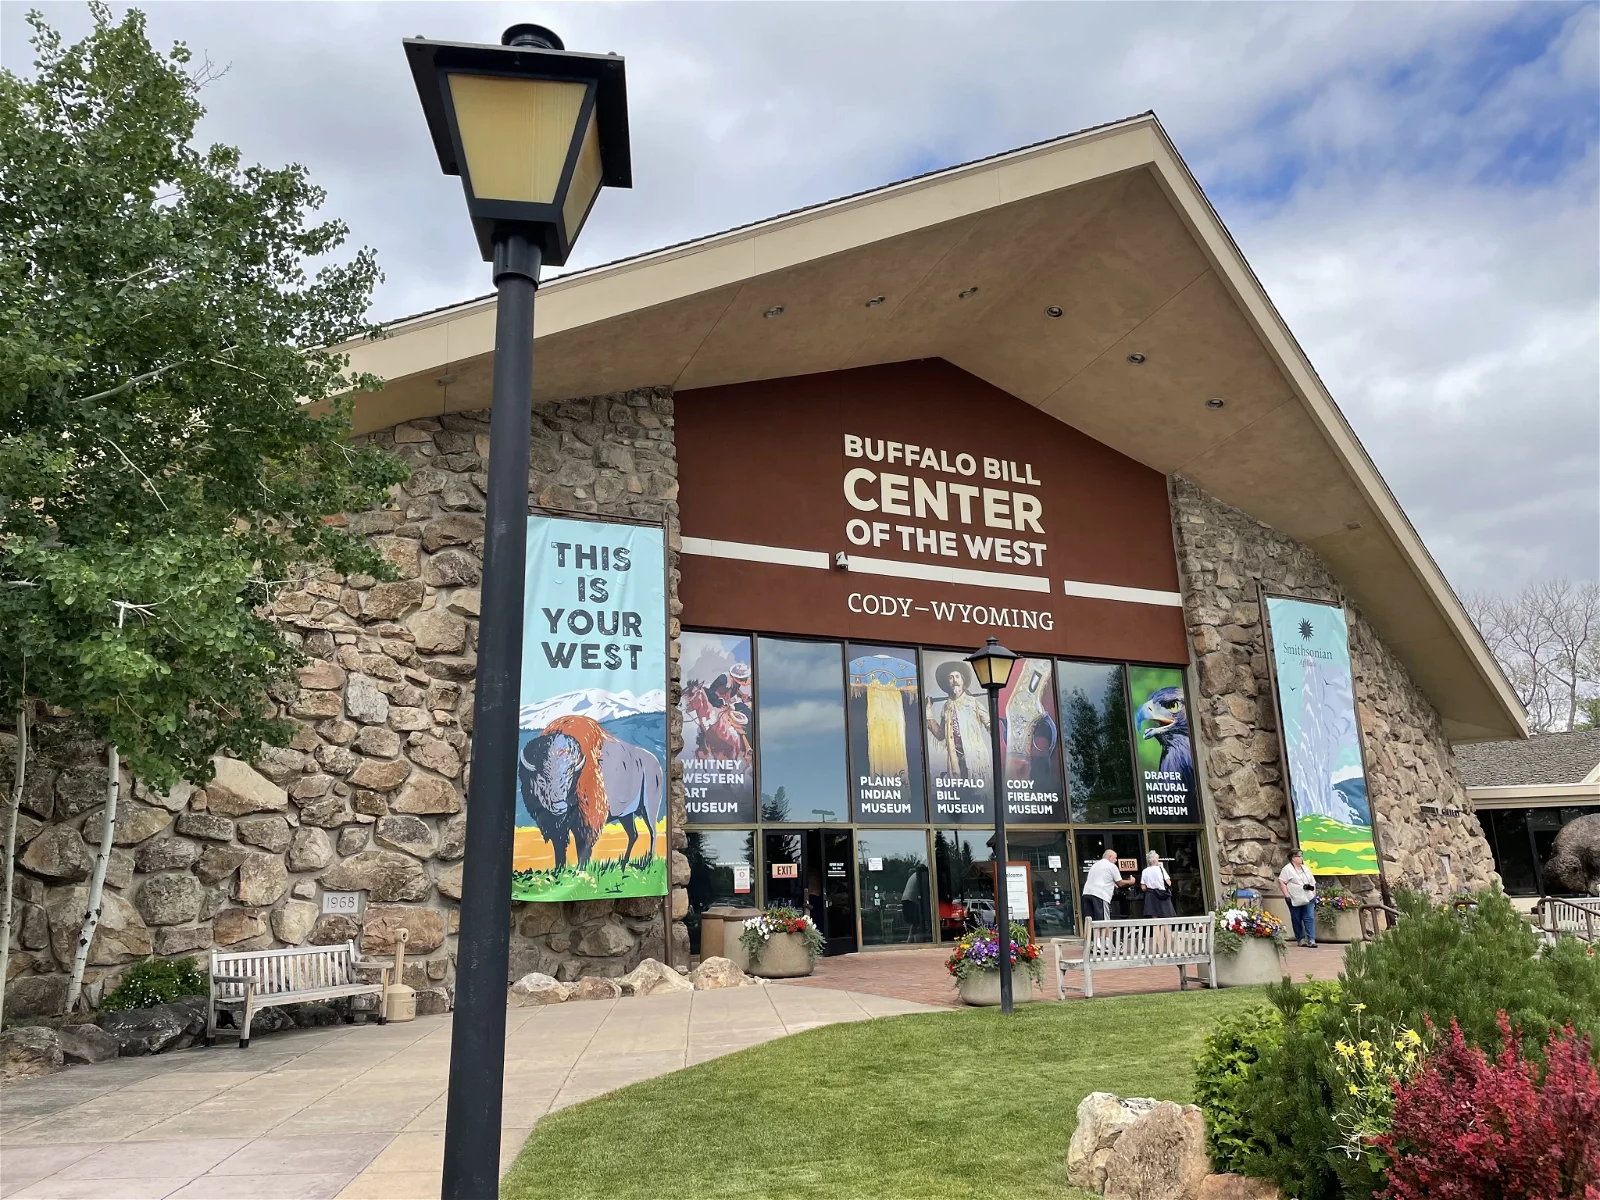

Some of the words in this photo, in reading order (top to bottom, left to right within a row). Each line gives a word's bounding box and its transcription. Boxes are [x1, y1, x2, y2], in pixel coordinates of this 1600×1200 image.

[844, 433, 977, 476] BUFFALO
[983, 456, 1041, 486] BILL
[843, 467, 1046, 534] CENTER
[845, 518, 890, 548] OF
[895, 524, 958, 557] THE
[963, 533, 1047, 567] WEST
[551, 541, 631, 572] THIS
[577, 576, 609, 603] IS
[541, 607, 643, 637] YOUR
[541, 641, 643, 671] WEST
[1282, 642, 1333, 660] Smithsonian
[681, 758, 742, 770] WHITNEY
[683, 773, 744, 784] WESTERN
[1144, 770, 1182, 781] DRAPER
[860, 776, 902, 787] PLAINS
[935, 777, 985, 789] BUFFALO
[1006, 779, 1035, 789] CODY
[1145, 782, 1188, 792] NATURAL
[860, 789, 901, 800] INDIAN
[936, 790, 961, 801] BILL
[1007, 791, 1059, 802] FIREARMS
[1146, 794, 1186, 804] HISTORY
[861, 802, 912, 814] MUSEUM
[937, 803, 985, 814] MUSEUM
[1008, 804, 1053, 815] MUSEUM
[1148, 805, 1189, 816] MUSEUM
[1120, 860, 1136, 869] ENTER
[777, 865, 793, 876] EXIT
[326, 896, 355, 909] 1968
